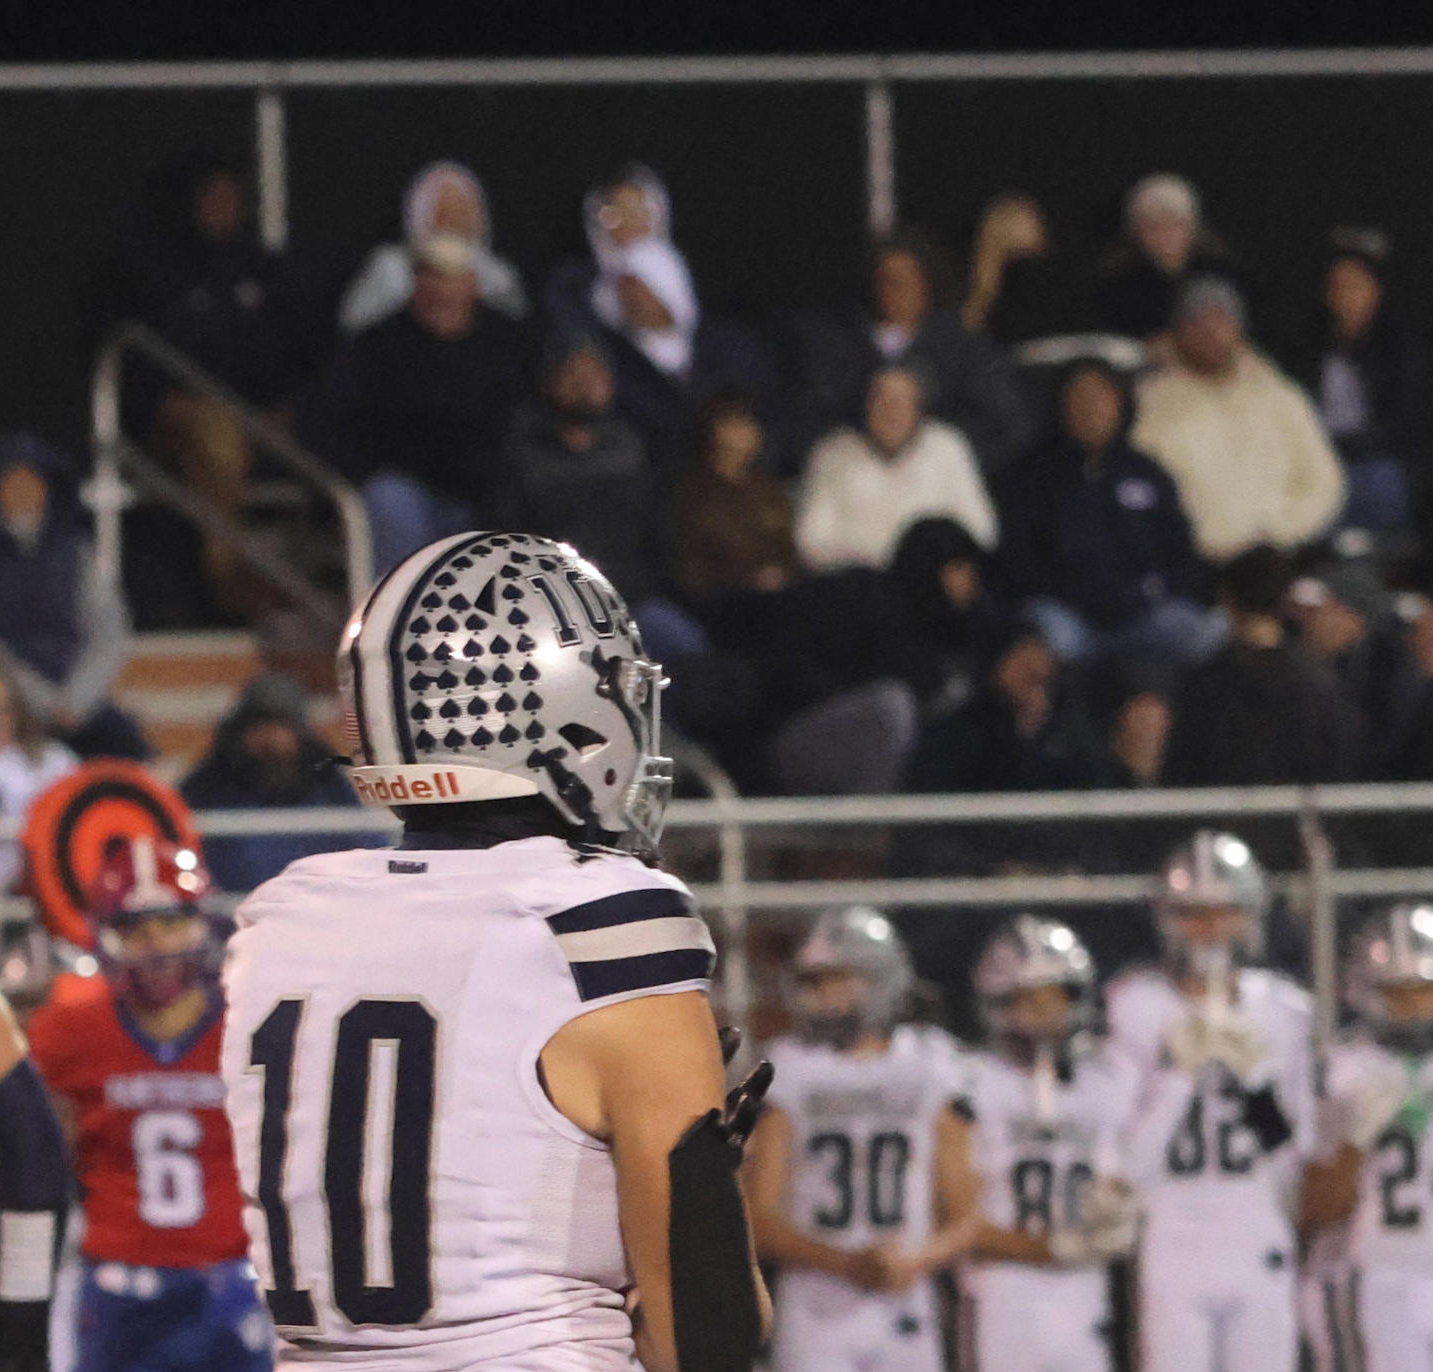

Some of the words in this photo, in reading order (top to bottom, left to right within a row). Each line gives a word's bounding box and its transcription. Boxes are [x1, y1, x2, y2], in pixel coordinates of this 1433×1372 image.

[525, 572, 616, 648] 10
[133, 1112, 205, 1229] 6
[244, 993, 444, 1333] 10
[808, 1131, 911, 1229] 30
